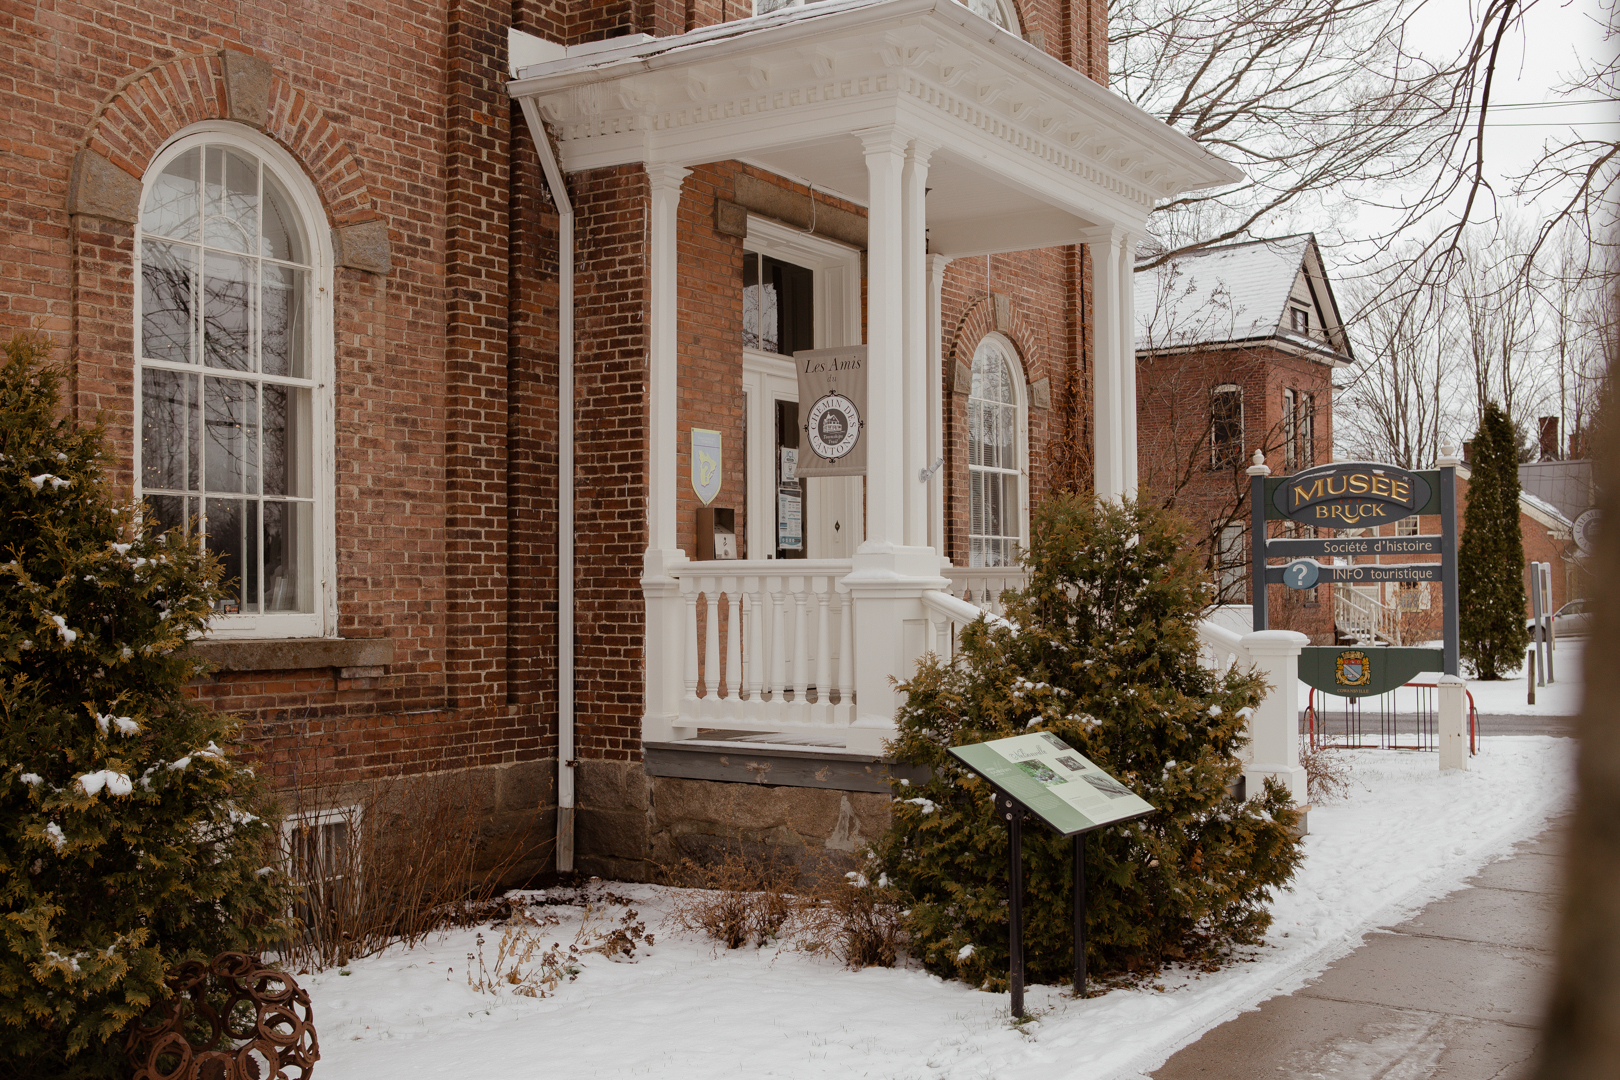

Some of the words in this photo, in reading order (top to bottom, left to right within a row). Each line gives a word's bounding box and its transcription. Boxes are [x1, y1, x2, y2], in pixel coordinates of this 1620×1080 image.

[805, 359, 826, 373] Les
[828, 355, 862, 371] Amis
[826, 374, 837, 382] du
[811, 399, 843, 430] CHEMIN
[843, 405, 857, 428] DES
[813, 433, 854, 455] CANTONS
[1294, 473, 1410, 506] MUSÉE
[1315, 503, 1387, 524] BRUCK
[1323, 541, 1368, 553] Société
[1374, 540, 1433, 552] d'histoire
[1333, 568, 1364, 580] INFO
[1371, 568, 1433, 582] touristique
